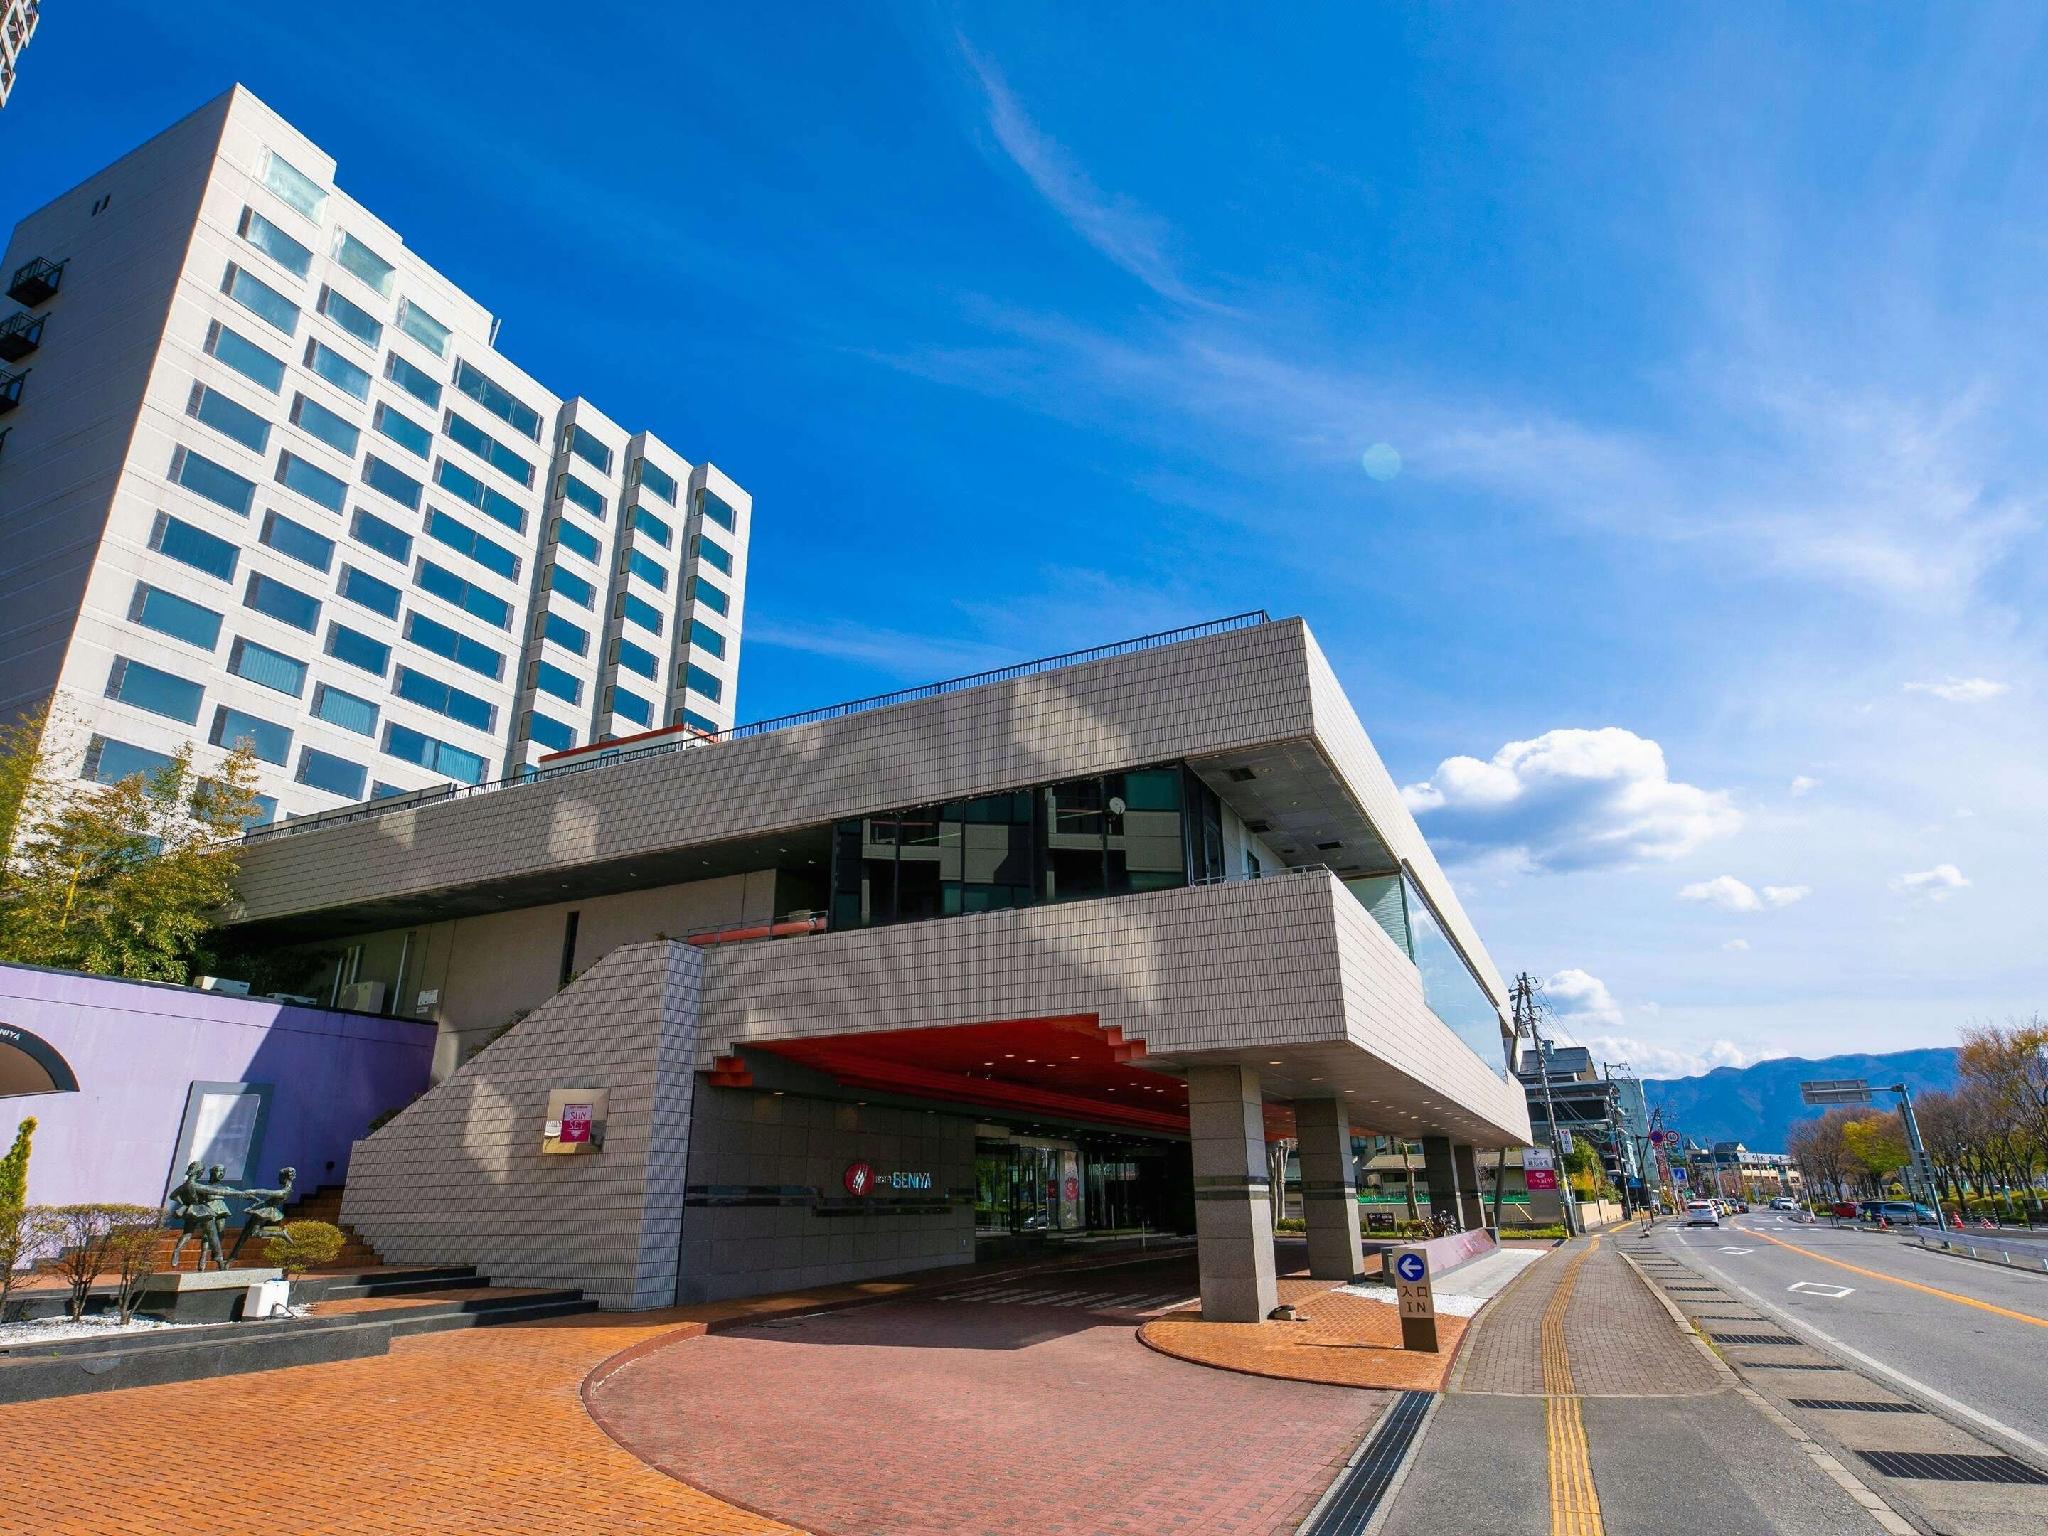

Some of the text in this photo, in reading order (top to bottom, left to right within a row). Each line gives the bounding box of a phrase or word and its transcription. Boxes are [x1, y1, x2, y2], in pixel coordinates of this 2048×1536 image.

[570, 1111, 587, 1120] SUN
[569, 1120, 585, 1130] SET
[1401, 1285, 1428, 1298] 入口
[1406, 1301, 1426, 1313] IN
